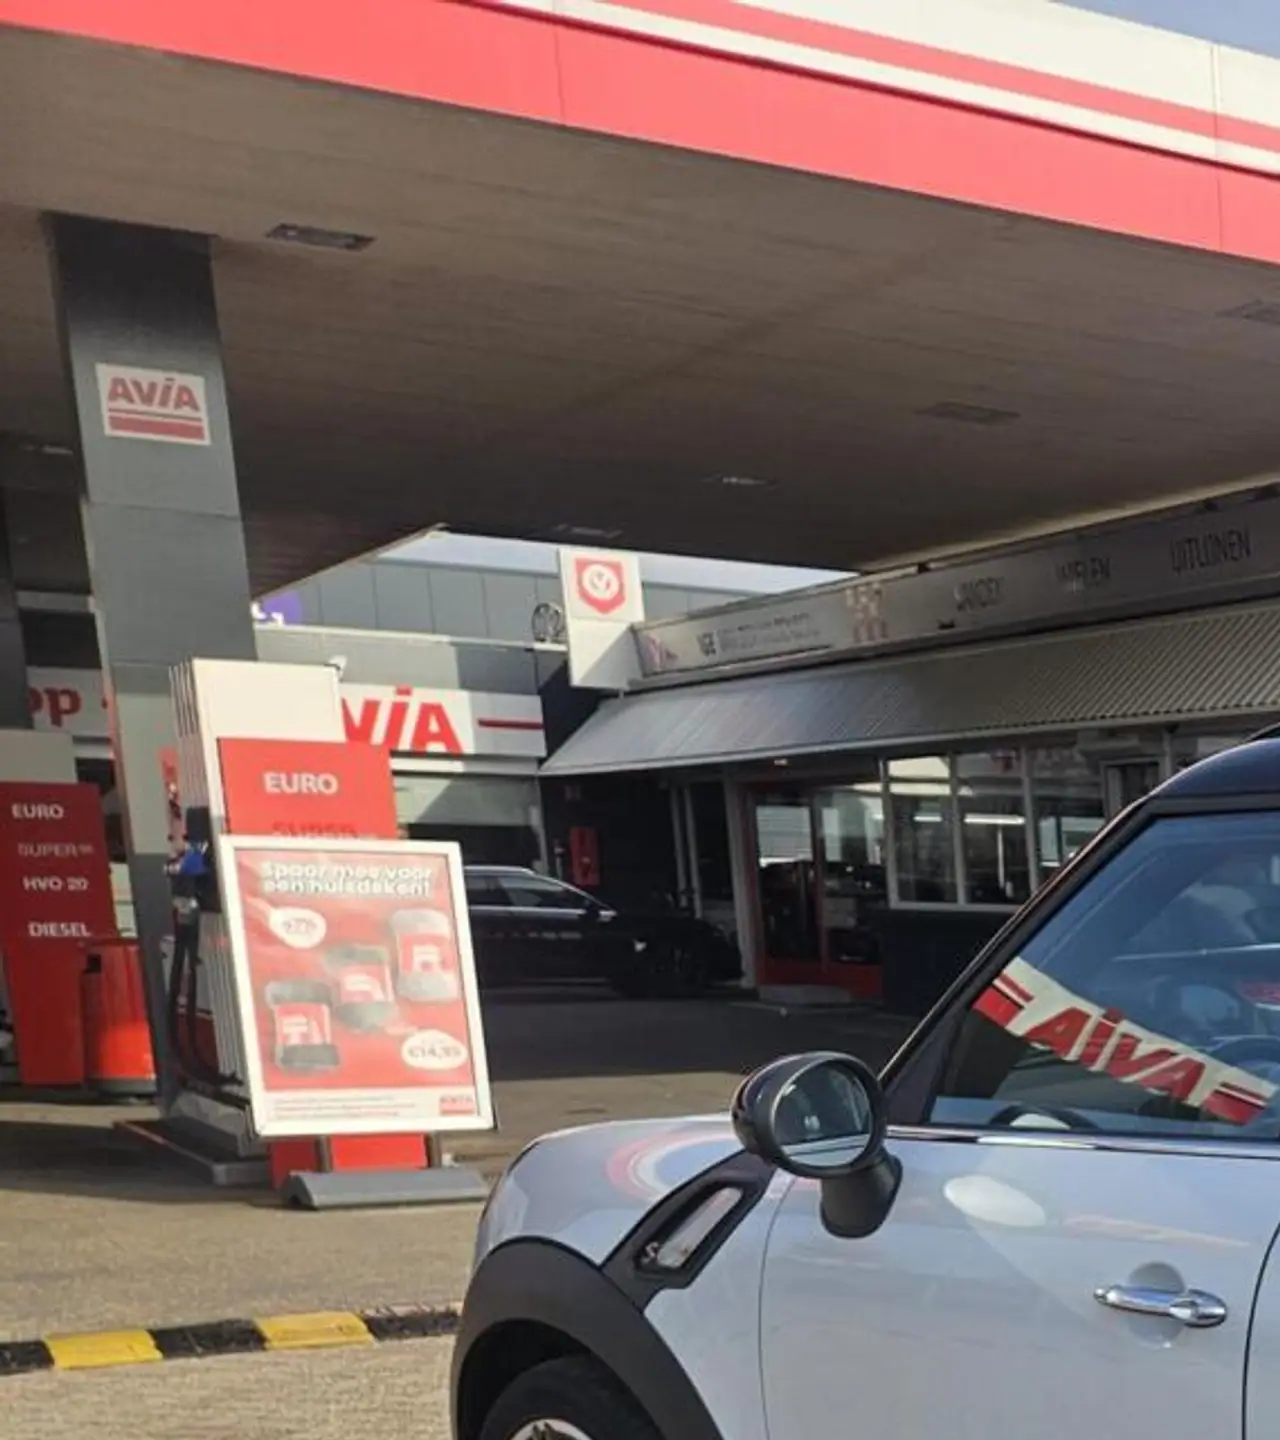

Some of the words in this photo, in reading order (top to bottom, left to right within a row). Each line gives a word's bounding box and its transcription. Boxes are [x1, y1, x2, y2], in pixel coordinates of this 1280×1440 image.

[264, 772, 339, 795] EURO
[11, 804, 64, 820] EURO
[17, 842, 77, 858] SUPER
[22, 875, 63, 892] HVO
[67, 875, 90, 892] 20
[28, 921, 92, 938] DIESEL
